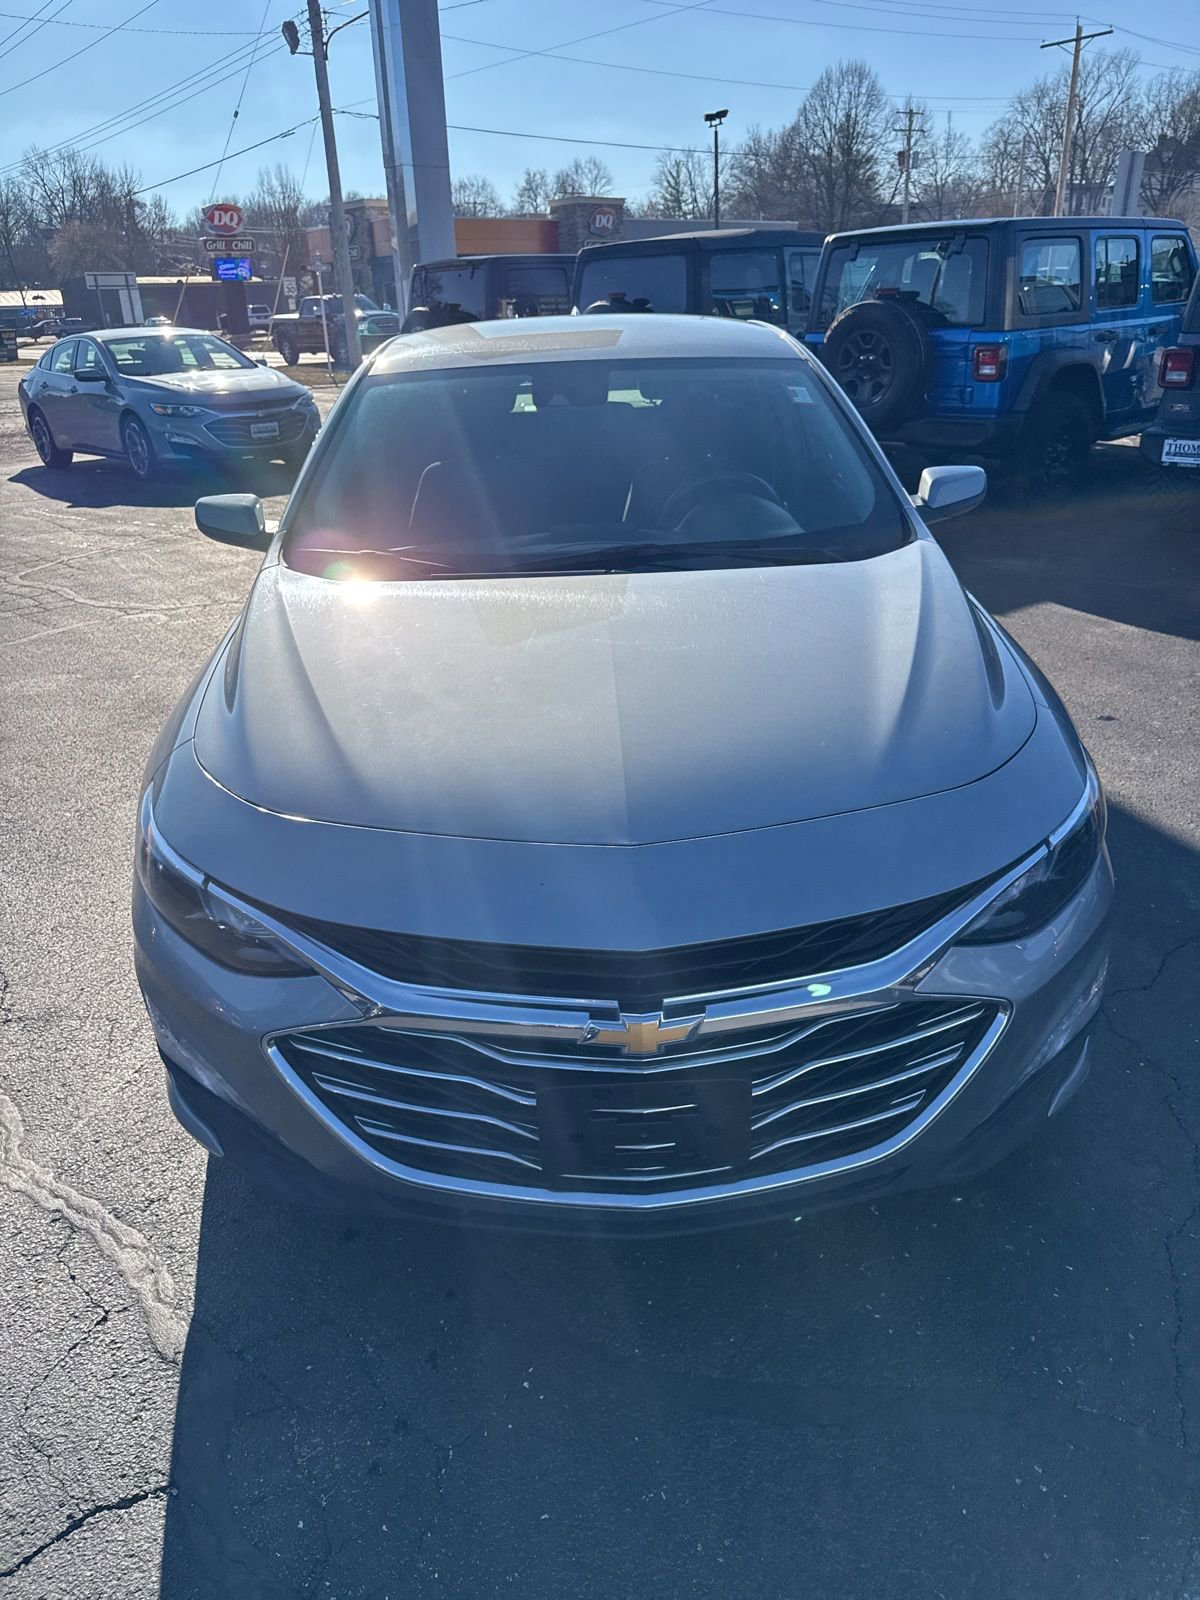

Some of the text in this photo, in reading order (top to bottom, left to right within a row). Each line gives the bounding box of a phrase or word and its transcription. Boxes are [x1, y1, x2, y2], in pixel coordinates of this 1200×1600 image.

[213, 210, 239, 228] DQ
[595, 214, 612, 229] DQ
[206, 241, 253, 250] Grill Chill
